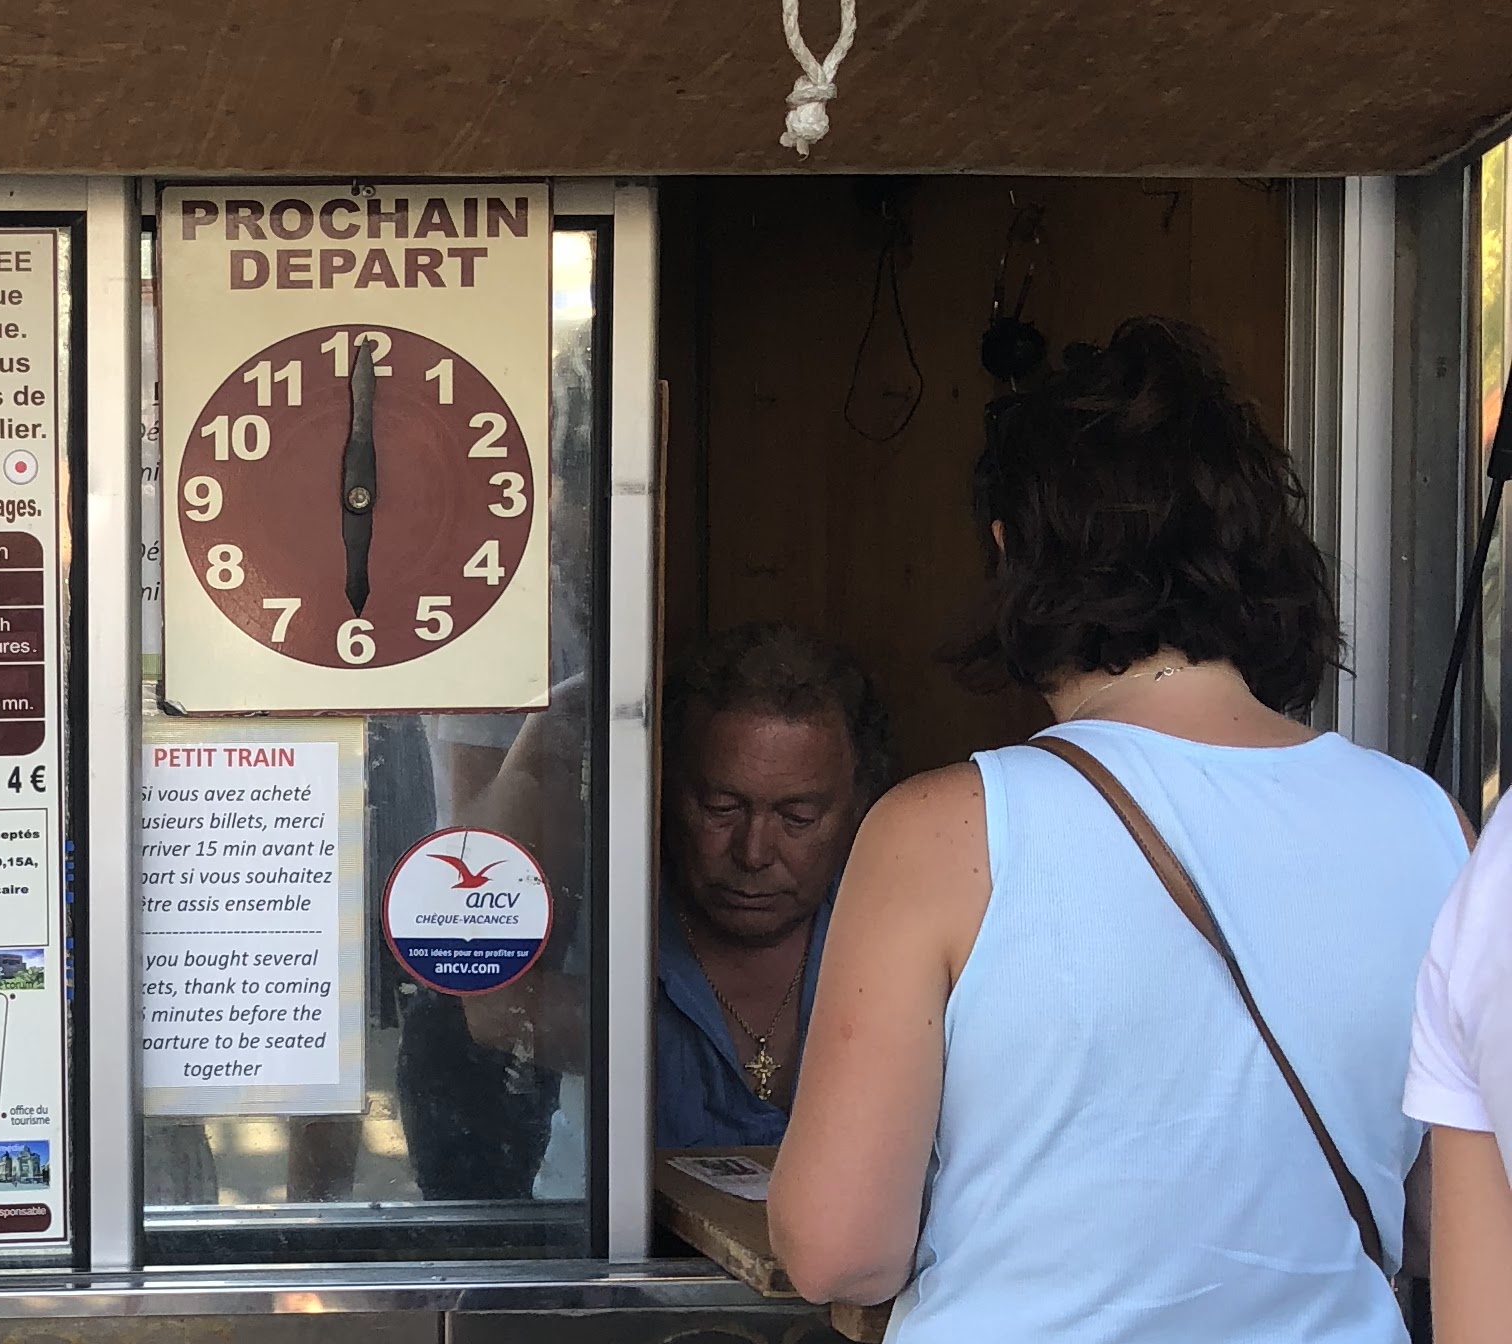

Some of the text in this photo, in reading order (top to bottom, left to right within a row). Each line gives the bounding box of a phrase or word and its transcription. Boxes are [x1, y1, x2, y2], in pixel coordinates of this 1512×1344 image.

[181, 196, 530, 241] PROCHAIN
[230, 246, 489, 291] DEPART
[320, 330, 393, 378] 12
[243, 360, 303, 407] 11
[425, 358, 455, 405] 1
[13, 384, 47, 407] de
[200, 414, 272, 461] 10
[468, 412, 509, 459] 2
[185, 476, 224, 522] 9
[488, 471, 528, 518] 3
[206, 543, 245, 590] 8
[463, 539, 506, 586] 4
[262, 597, 302, 644] 7
[414, 595, 454, 641] 5
[336, 617, 377, 665] 6
[2, 698, 35, 712] mn.
[154, 747, 296, 768] PETIT TRAIN
[7, 765, 23, 794] 4
[29, 764, 47, 793] €
[158, 788, 199, 803] vous
[204, 787, 246, 802] avez
[250, 783, 313, 802] acheté
[210, 812, 269, 832] billets,
[273, 812, 326, 830] merci
[195, 841, 218, 858] 15
[223, 840, 257, 857] min
[261, 841, 315, 857] avant
[319, 839, 336, 857] le
[179, 866, 333, 885] si vous souhaitez
[177, 894, 312, 913] assis ensemble
[465, 891, 522, 910] ancv
[414, 912, 520, 927] CHÈQUE-VACANCES
[145, 948, 319, 972] you bought several
[434, 962, 501, 975] ancv.com
[184, 976, 332, 998] thank to coming
[151, 1005, 224, 1024] minutes
[228, 1004, 288, 1025] before
[292, 1003, 323, 1022] the
[214, 1034, 234, 1050] to
[237, 1031, 261, 1050] be
[264, 1031, 327, 1049] seated
[183, 1059, 264, 1082] together
[11, 1114, 51, 1126] tourisme
